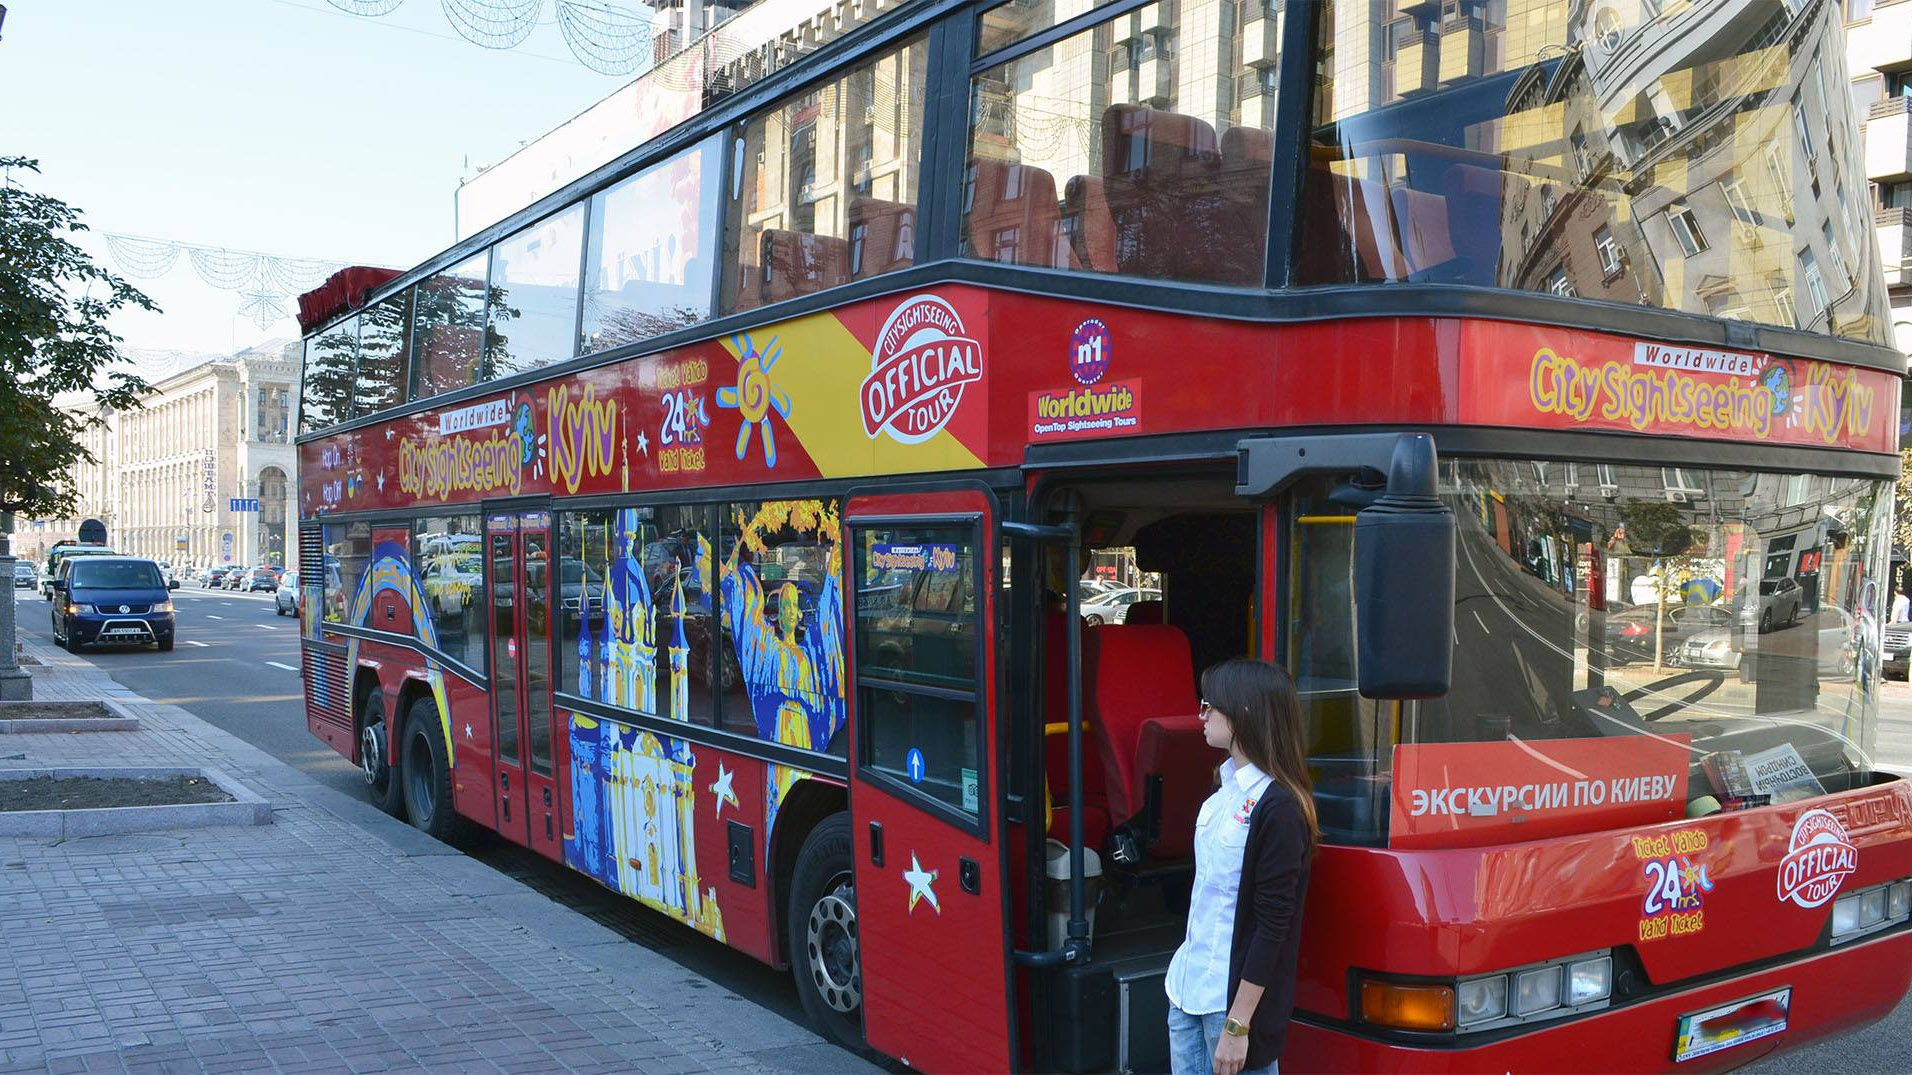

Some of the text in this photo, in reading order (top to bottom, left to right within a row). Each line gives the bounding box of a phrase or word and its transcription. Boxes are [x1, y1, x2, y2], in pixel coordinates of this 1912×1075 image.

[884, 304, 958, 356] CITYSIGHTSEEING
[1645, 345, 1748, 373] Worldwide
[868, 346, 980, 424] OFFICIAL
[1038, 386, 1133, 418] Worldwide
[1804, 361, 1874, 444] Kyiv
[445, 406, 504, 429] Worldwide
[907, 388, 954, 432] TOUR
[1067, 419, 1113, 432] Sightseeing
[1113, 416, 1137, 427] Tours
[547, 384, 616, 494] Kyiv
[1410, 774, 1677, 817] ЭКСКУРСИИ ПО КИЕВУ
[1632, 835, 1671, 859] Ticket
[1645, 860, 1682, 914] 24
[1784, 847, 1855, 891] OFFICIAL
[1806, 874, 1838, 901] TOUR
[1640, 911, 1703, 940] Valid Ticket
